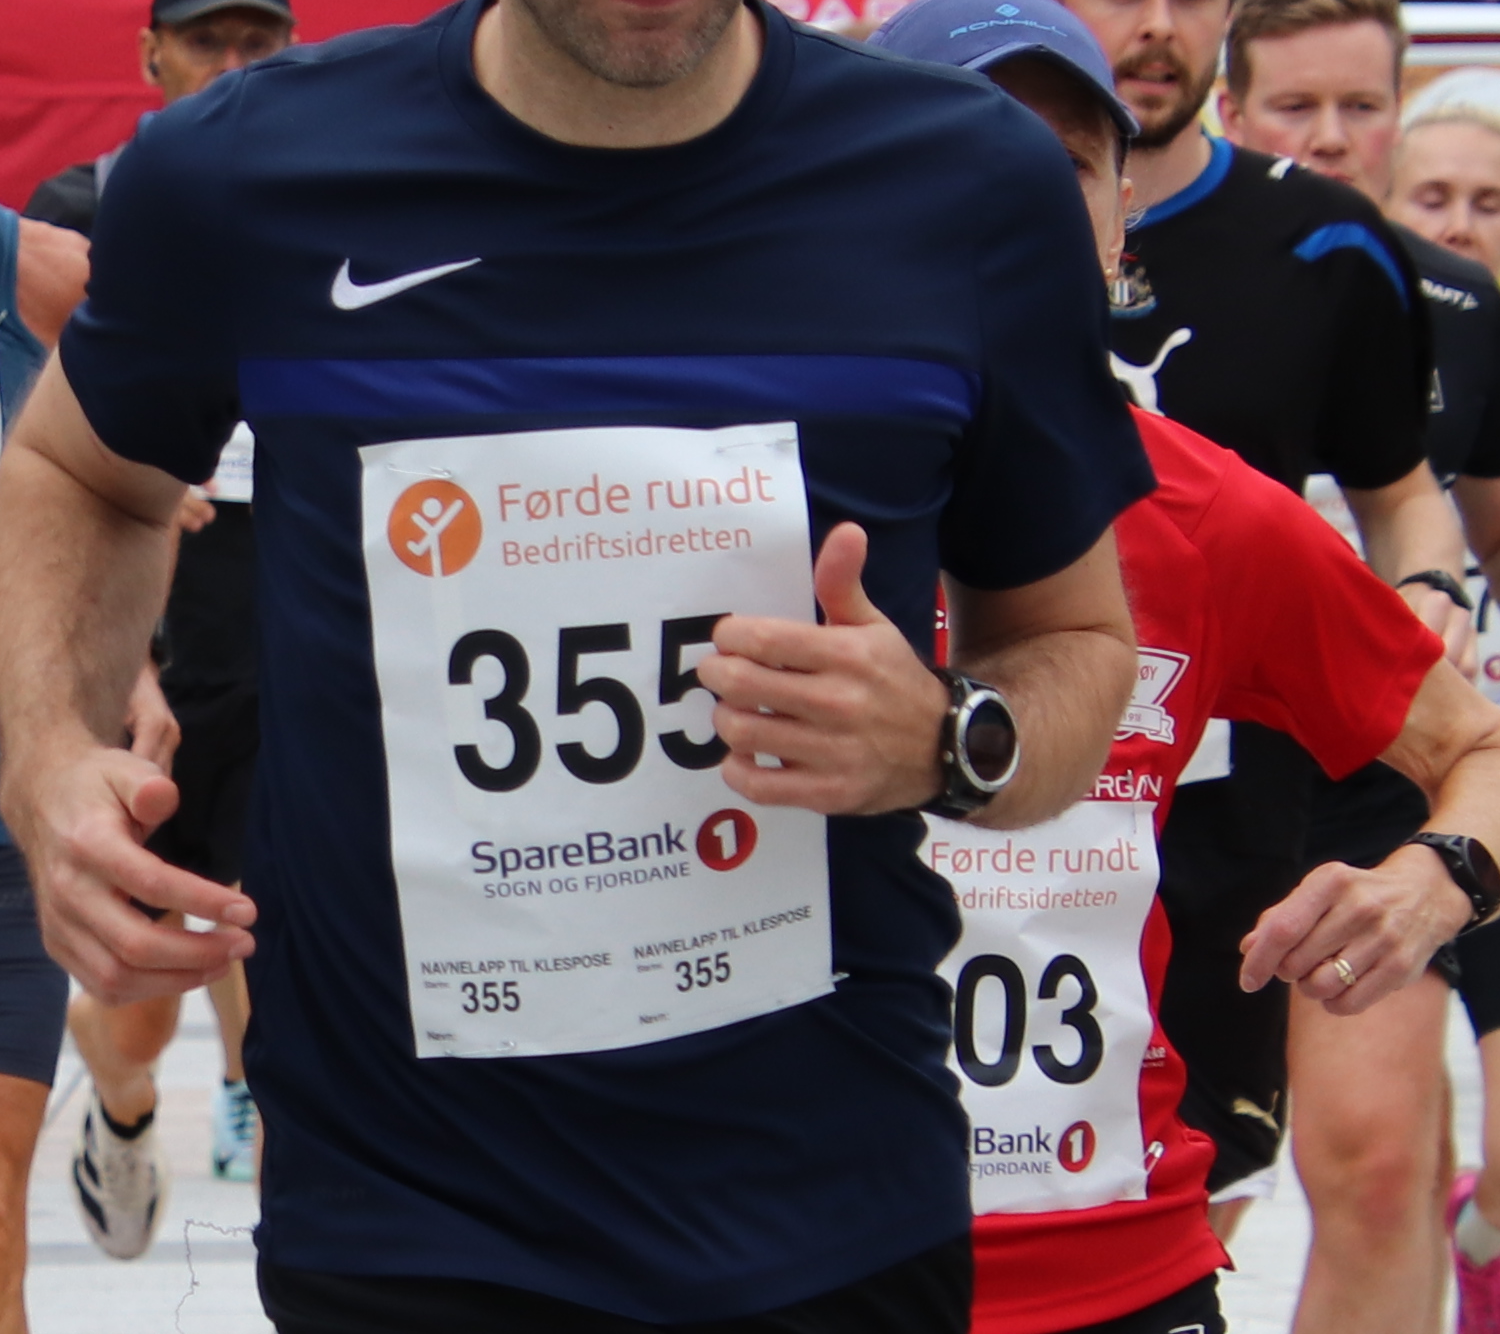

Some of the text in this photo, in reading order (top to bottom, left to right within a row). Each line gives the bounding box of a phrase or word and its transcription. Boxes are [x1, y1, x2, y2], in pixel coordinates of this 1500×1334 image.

[949, 18, 1068, 40] RONHILL
[1420, 277, 1465, 305] RAFT
[498, 467, 775, 522] Førde rundt
[503, 527, 751, 567] Bedriftsidretten
[448, 613, 733, 792] 355
[471, 823, 687, 879] SpareBank
[931, 838, 1140, 874] Førde rundt
[484, 862, 691, 899] SOGN OG FJORDANE
[953, 886, 1118, 910] driftsidretten
[634, 905, 812, 959] NAVNELAPP TIL KLESPOSE
[421, 953, 612, 975] NAVNELAPP TIL KLESPOSE
[676, 952, 731, 993] 355
[461, 981, 520, 1014] 355
[954, 953, 1104, 1088] 03
